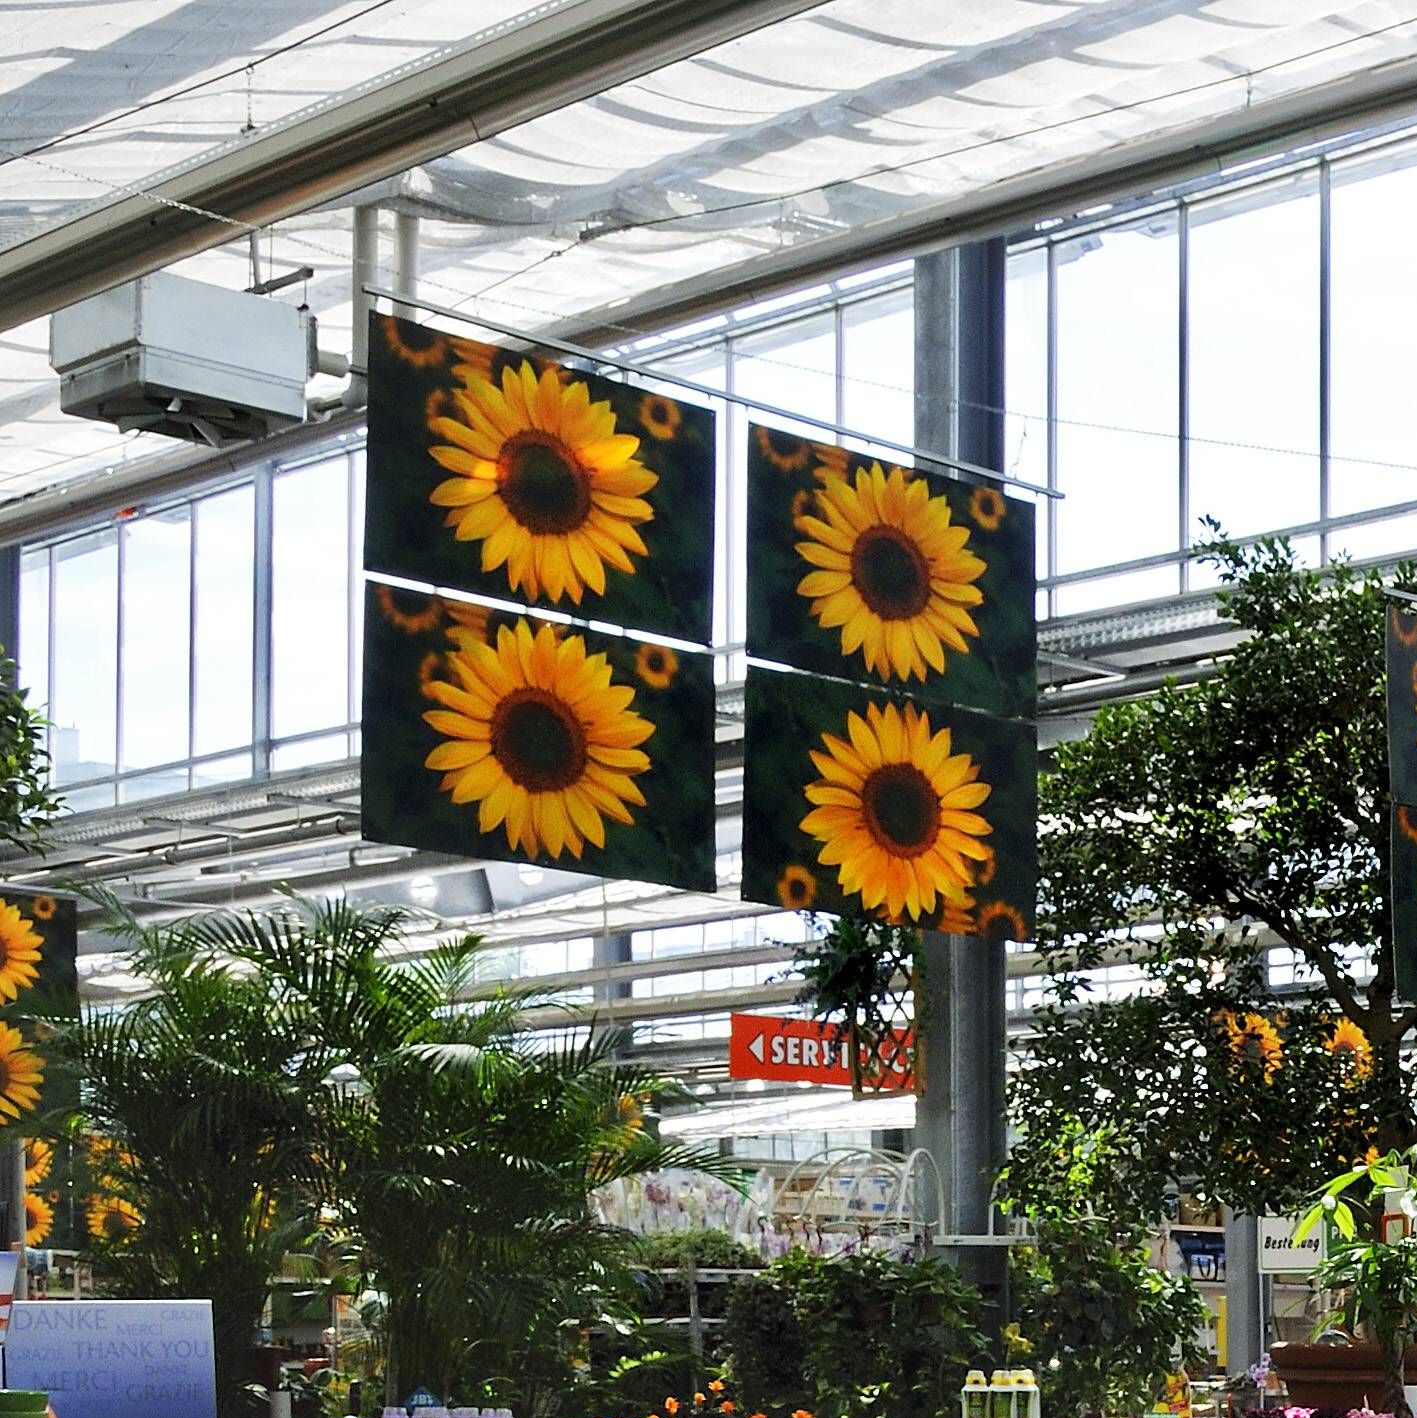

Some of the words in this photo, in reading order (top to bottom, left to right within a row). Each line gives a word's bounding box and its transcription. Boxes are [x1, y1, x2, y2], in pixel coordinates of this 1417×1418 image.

[1264, 1235, 1320, 1253] Besteung
[14, 1308, 108, 1330] DANKE
[116, 1322, 163, 1336] MERCI
[71, 1340, 153, 1359] THANK
[161, 1339, 209, 1358] YOU
